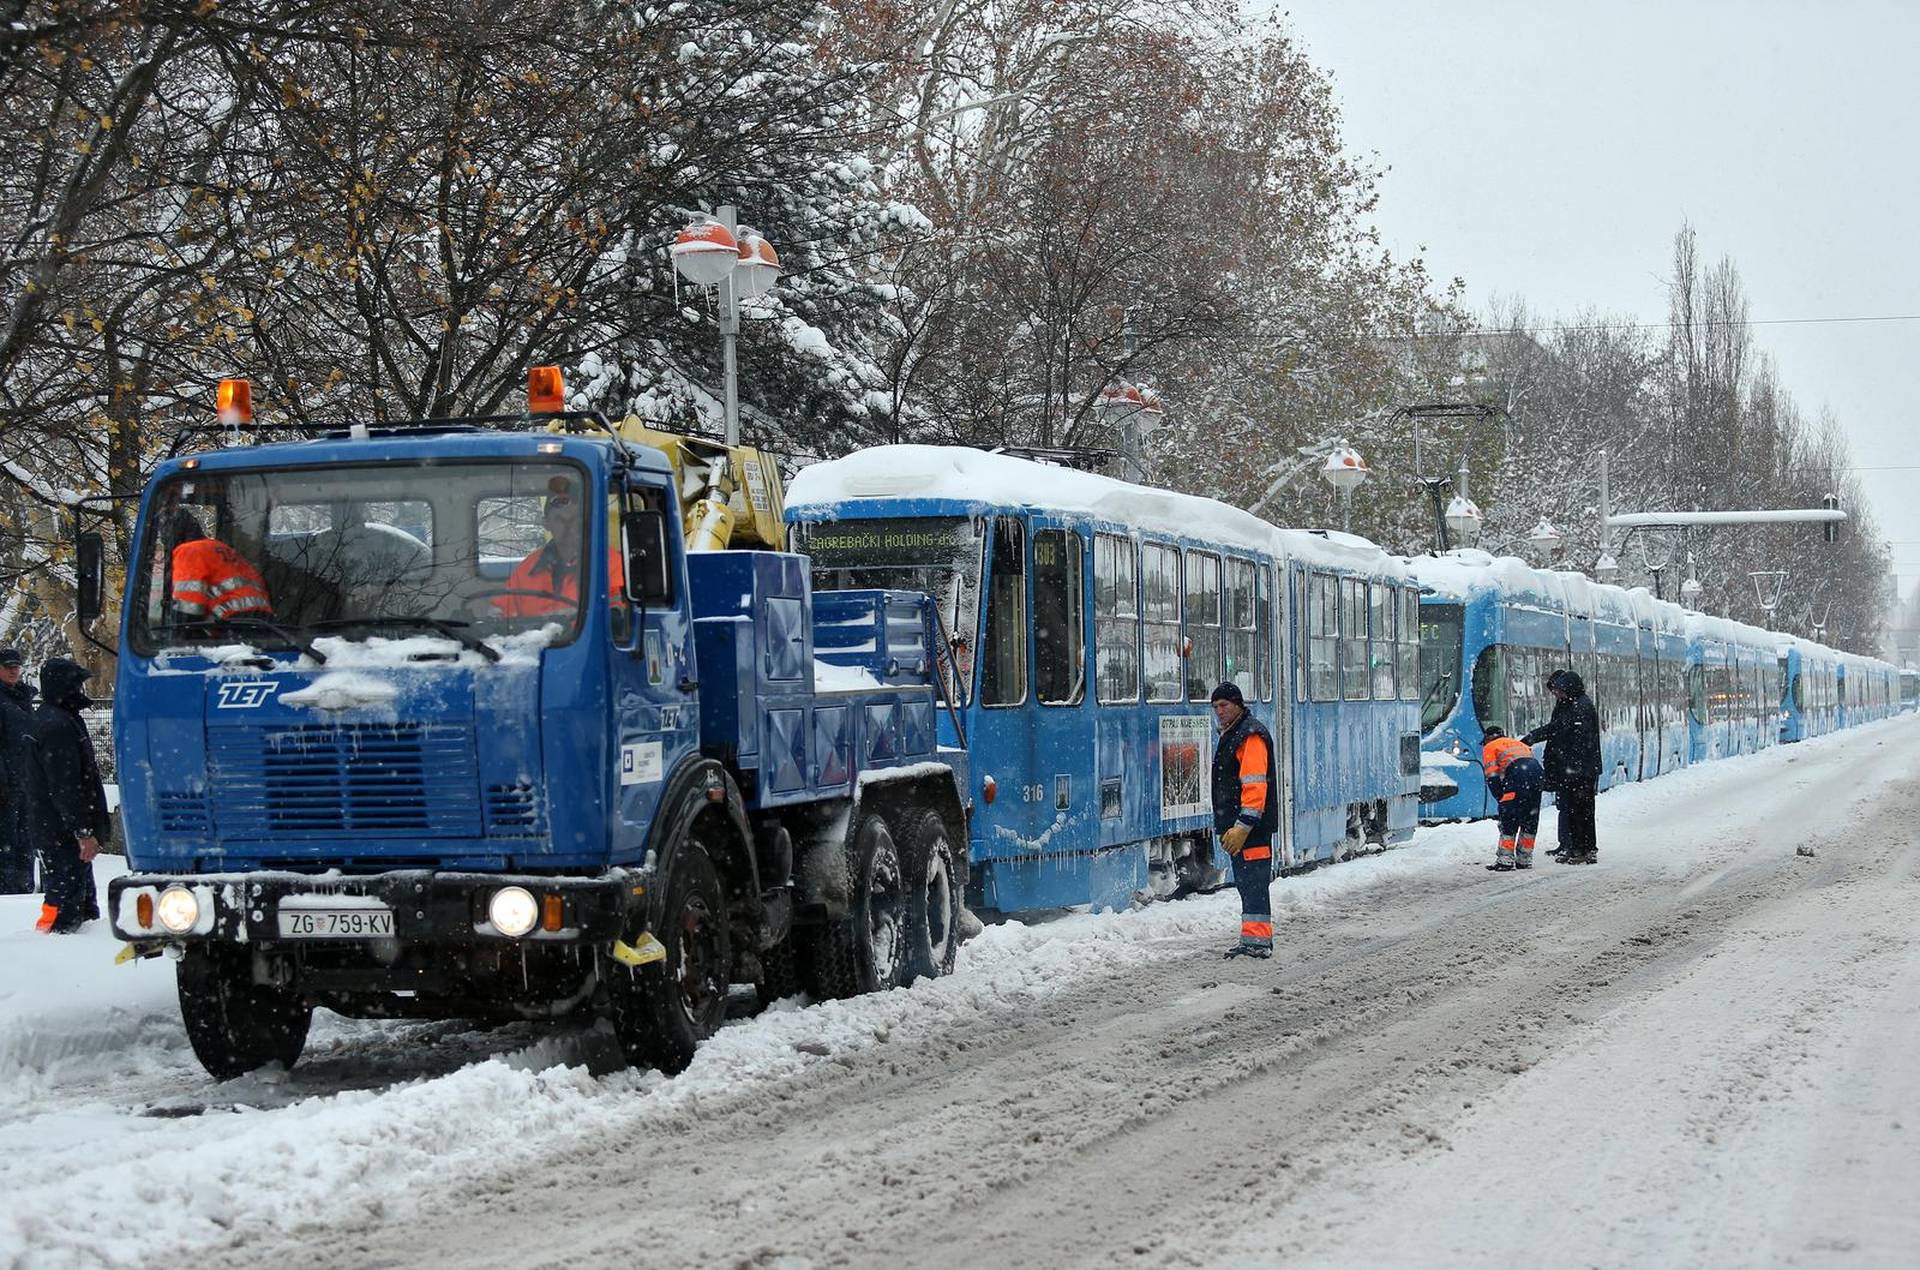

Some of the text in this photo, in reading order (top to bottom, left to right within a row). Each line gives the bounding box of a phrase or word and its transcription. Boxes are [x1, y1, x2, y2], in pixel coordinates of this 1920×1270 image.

[810, 532, 880, 550] ZAGREBAČKI
[217, 681, 280, 709] ZET
[1023, 783, 1044, 802] 316
[290, 914, 391, 934] ZG 759-KV
